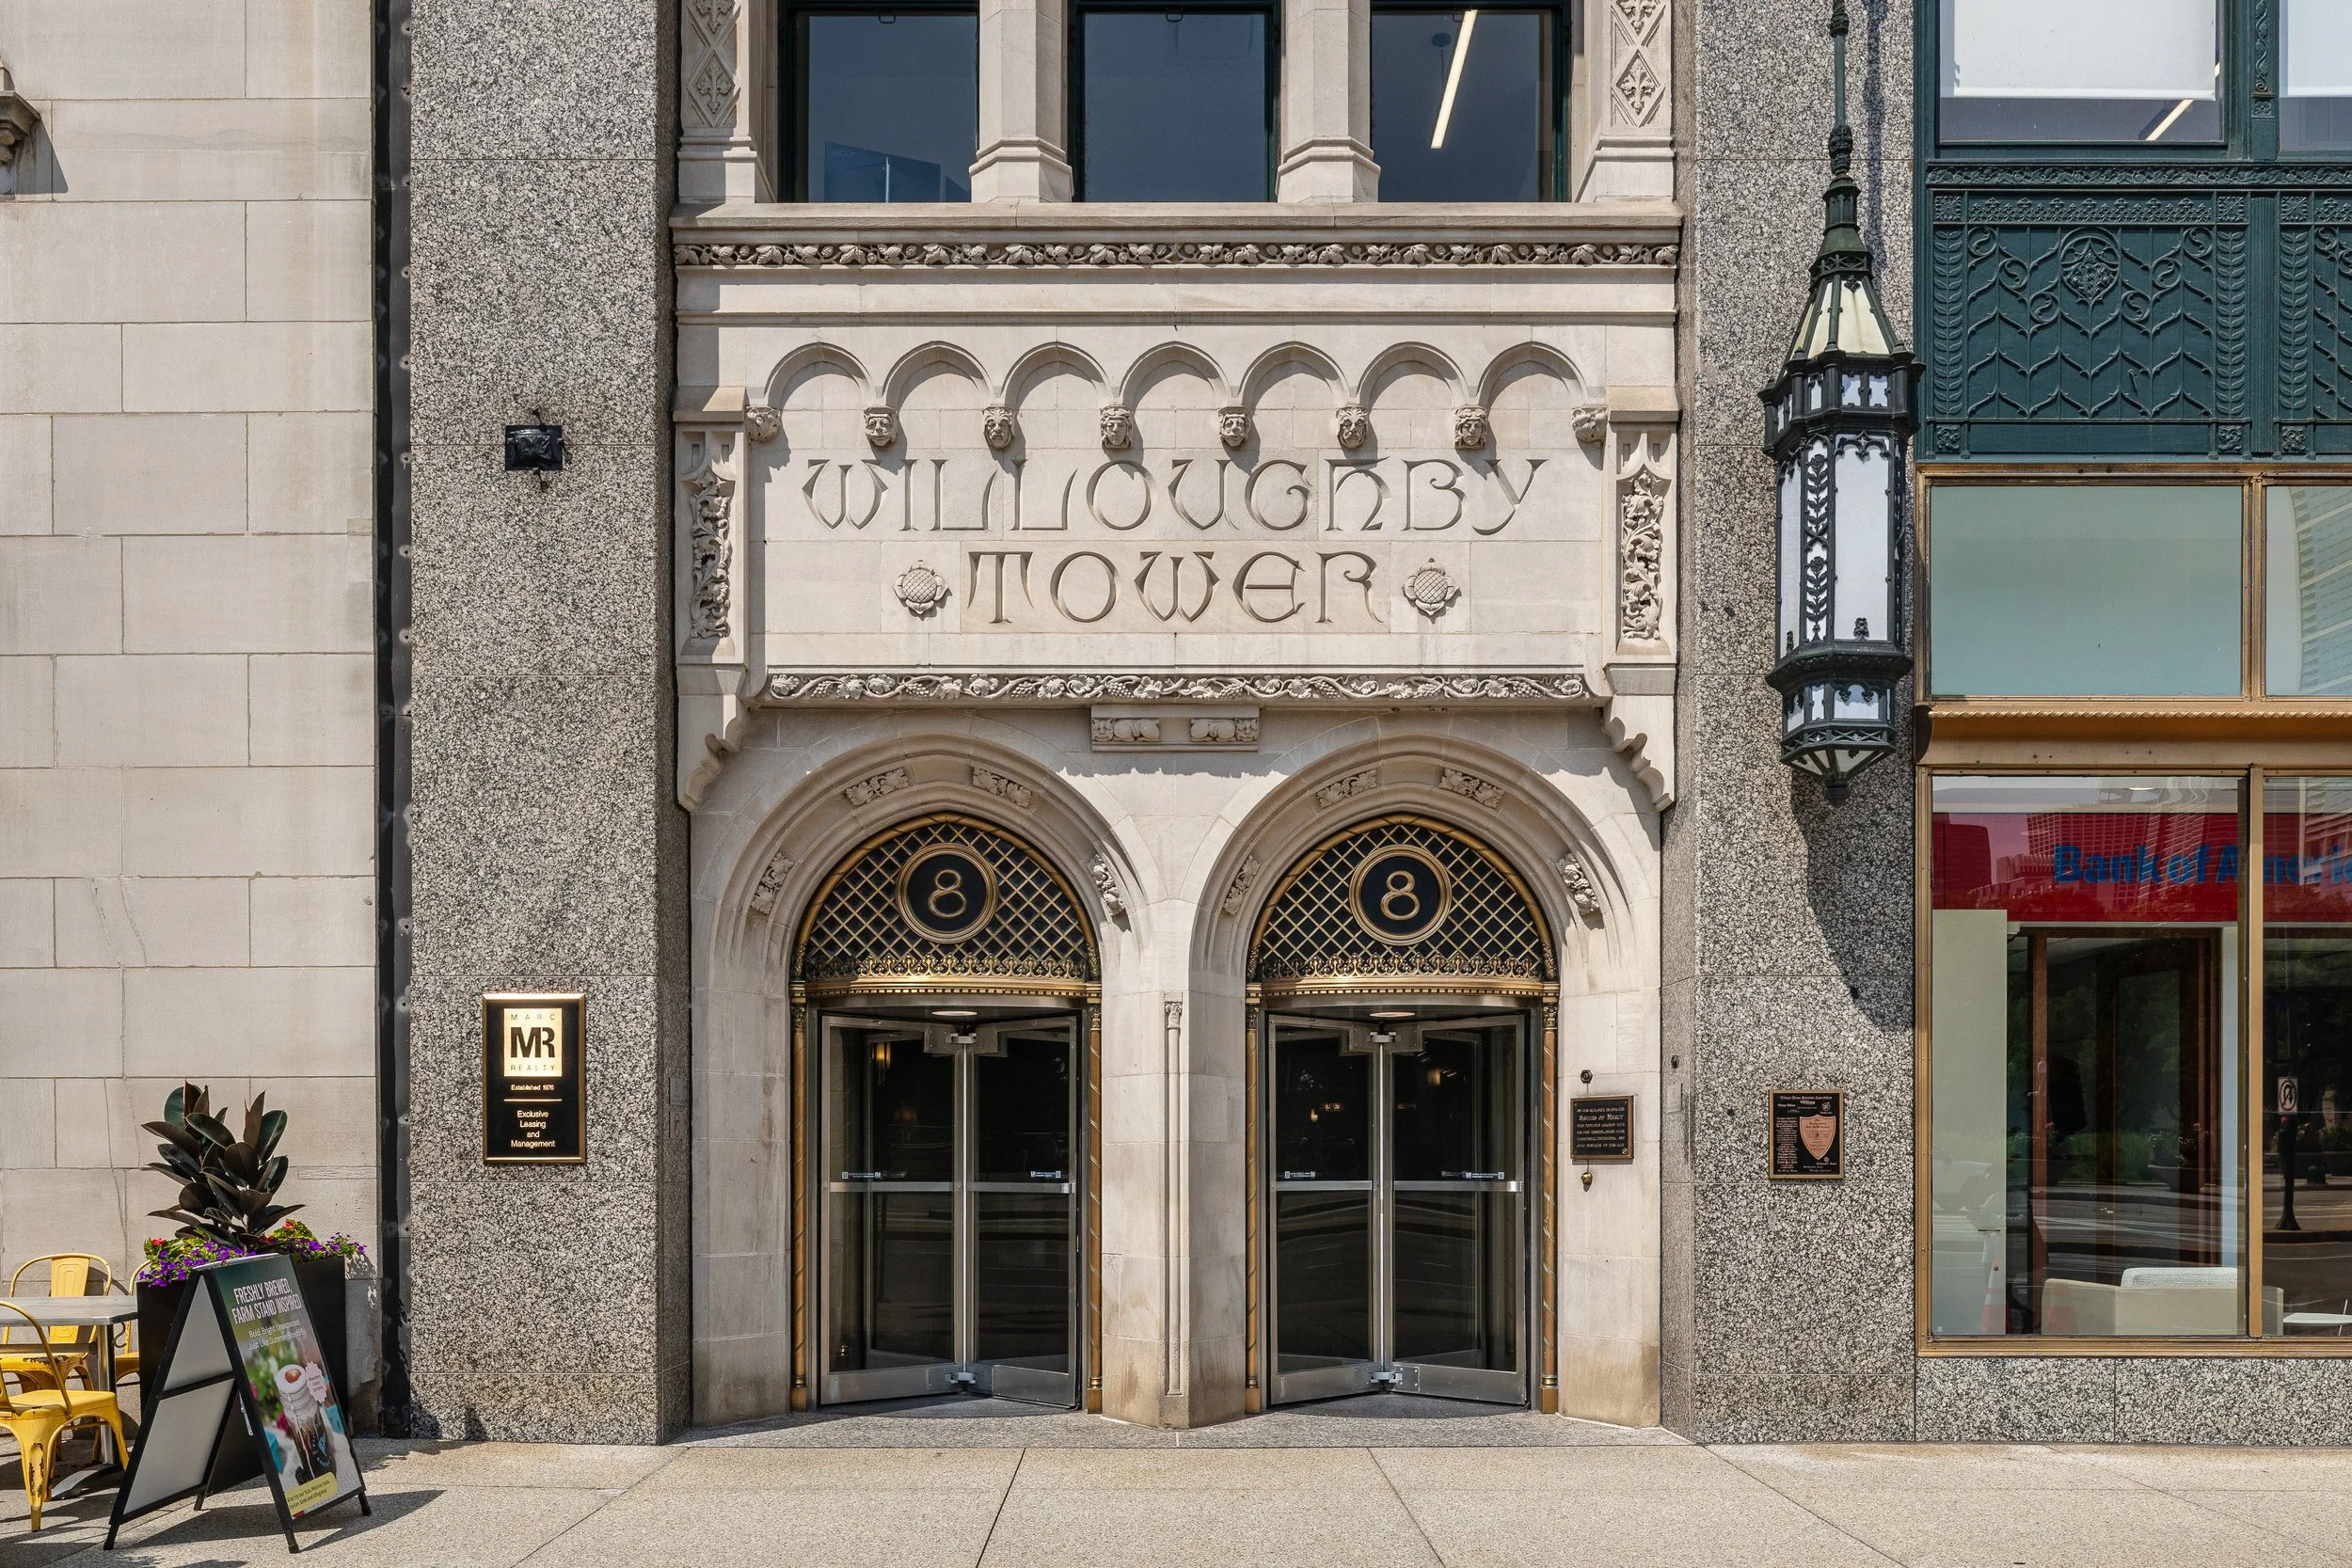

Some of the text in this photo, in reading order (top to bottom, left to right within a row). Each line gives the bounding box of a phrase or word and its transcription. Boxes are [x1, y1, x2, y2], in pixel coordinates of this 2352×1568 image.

[802, 456, 1550, 535] WILLOUGHBY
[967, 551, 1384, 624] TOWER
[2054, 844, 2160, 883] Bank
[2167, 844, 2210, 883] of
[928, 869, 967, 919] 8
[1380, 870, 1421, 921] 8
[511, 1027, 556, 1058] MR
[519, 1120, 547, 1129] Leasing
[511, 1139, 556, 1148] Management
[233, 1277, 293, 1305] FRESHLY BREWED,
[231, 1293, 302, 1325] FARM STAND INSPIRED
[269, 1333, 288, 1345] Summer
